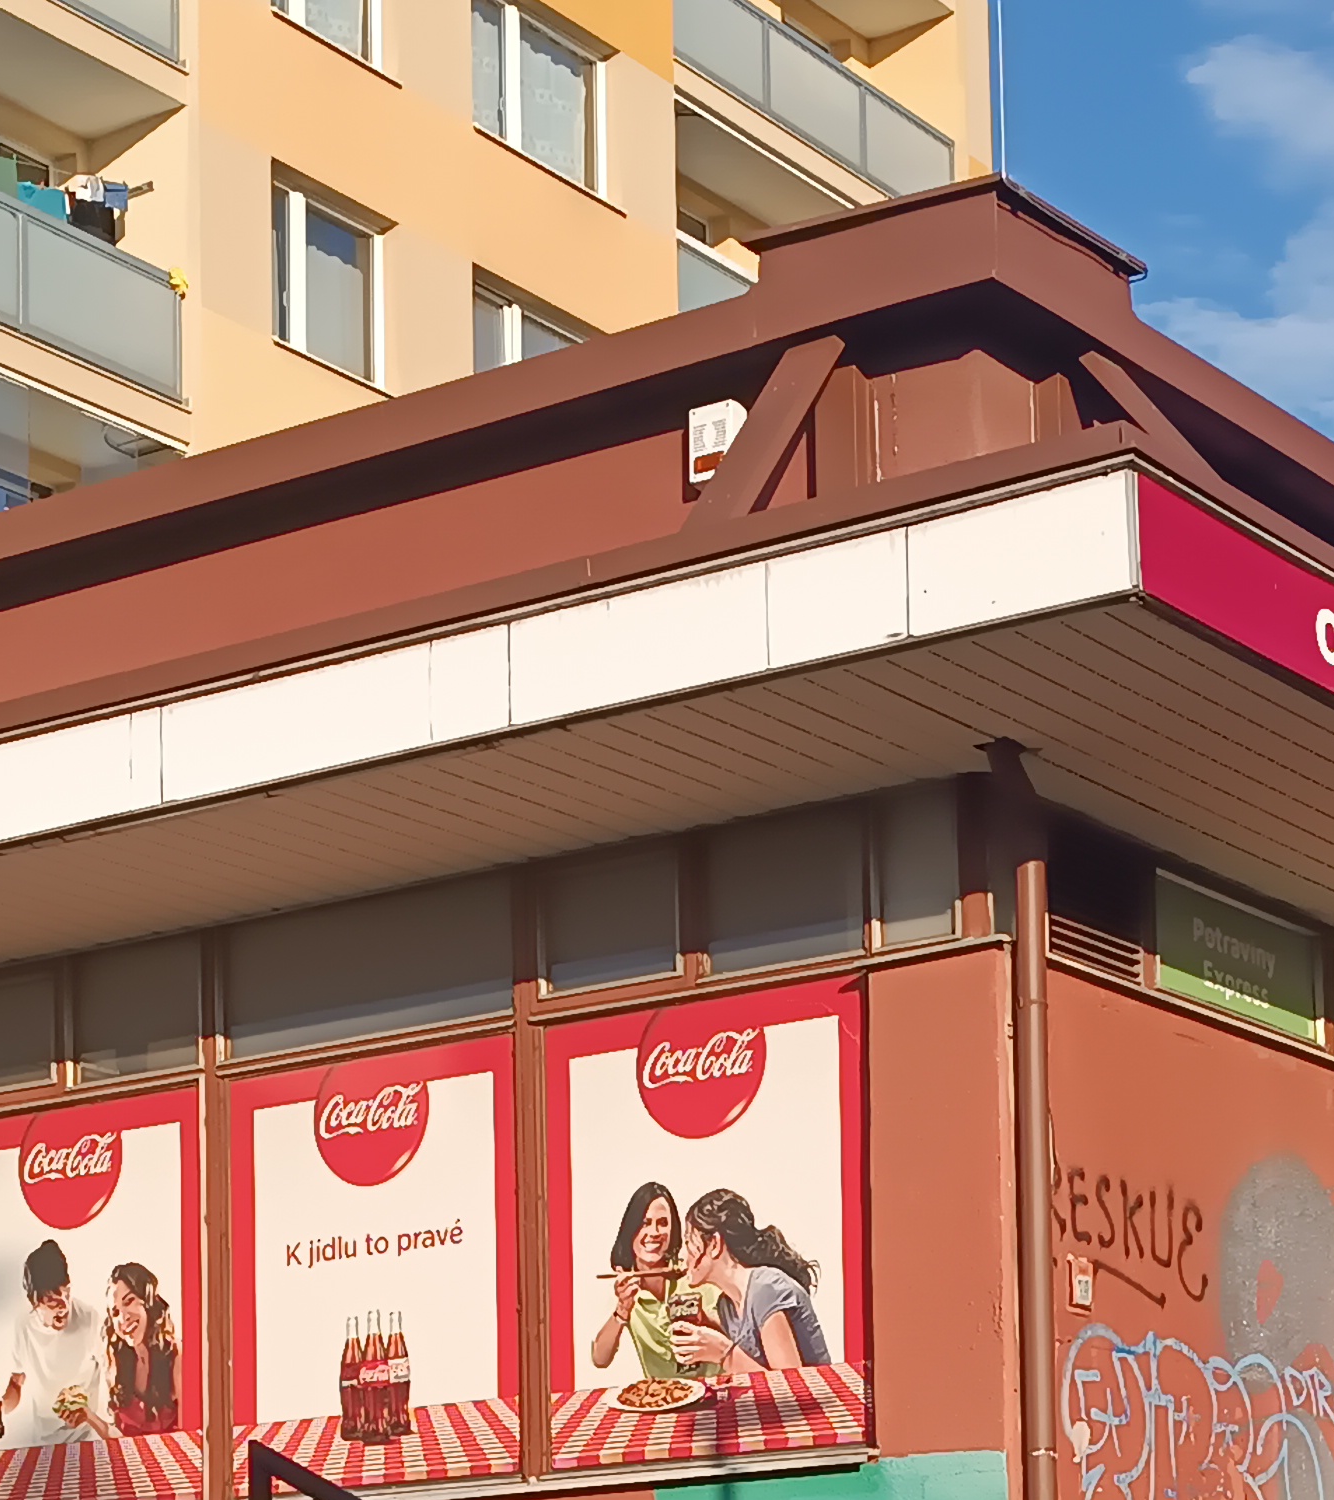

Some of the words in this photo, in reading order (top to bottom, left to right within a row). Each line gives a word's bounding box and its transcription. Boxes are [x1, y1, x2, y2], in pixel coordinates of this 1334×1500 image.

[1193, 917, 1276, 979] Potraviny
[643, 1026, 761, 1089] Coca-Cola
[286, 1242, 302, 1267] K
[308, 1235, 357, 1268] jídlu
[365, 1233, 389, 1256] to
[398, 1218, 464, 1257] pravé
